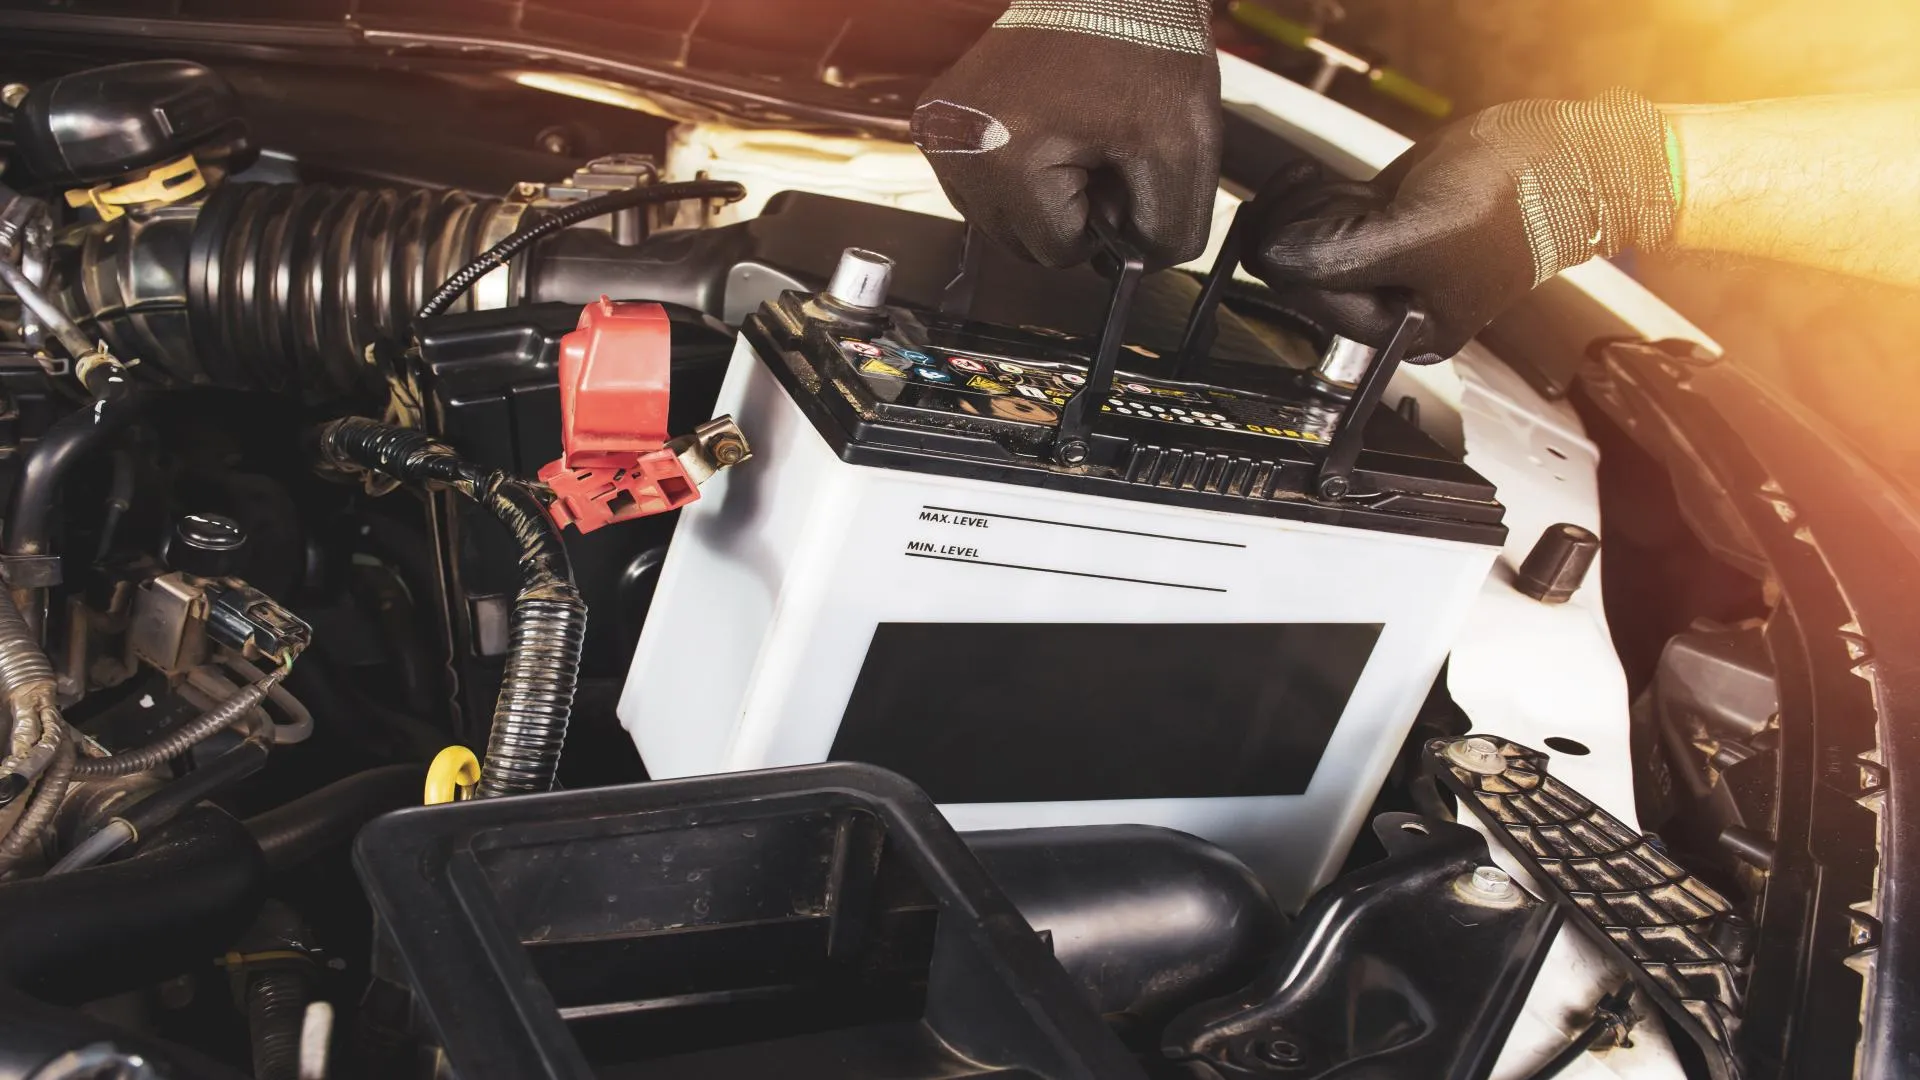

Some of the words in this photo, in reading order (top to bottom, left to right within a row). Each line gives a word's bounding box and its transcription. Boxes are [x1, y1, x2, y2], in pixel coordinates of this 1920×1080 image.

[919, 511, 951, 524] MAX.
[953, 515, 988, 528] LEVEL
[907, 541, 937, 553] MIN.
[940, 544, 979, 557] LEVEL
